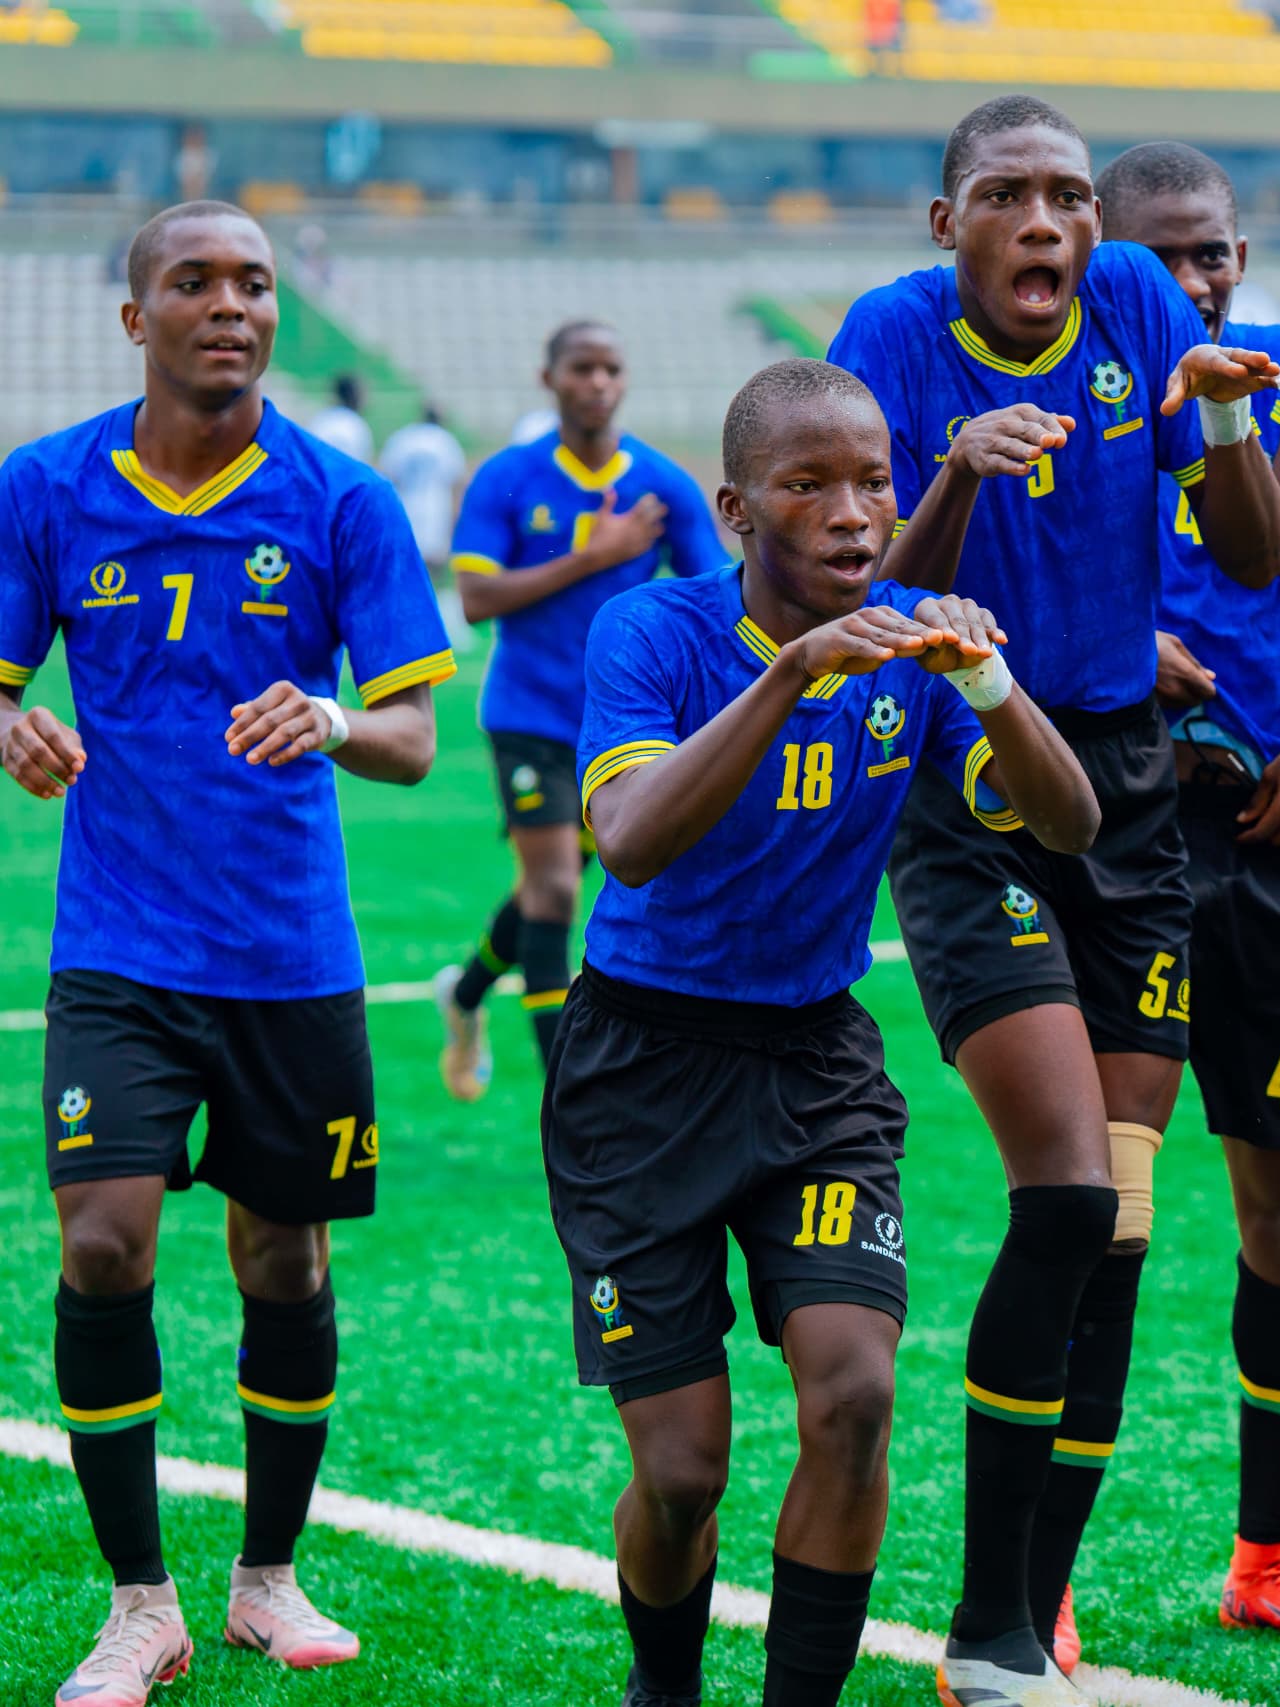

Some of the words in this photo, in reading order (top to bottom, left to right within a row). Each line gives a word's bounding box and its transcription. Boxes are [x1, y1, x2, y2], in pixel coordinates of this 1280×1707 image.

[1175, 488, 1204, 545] 4
[162, 573, 194, 641] 7
[776, 742, 833, 810] 18
[1138, 951, 1176, 1018] 5
[327, 1115, 357, 1180] 7
[793, 1182, 857, 1246] 18
